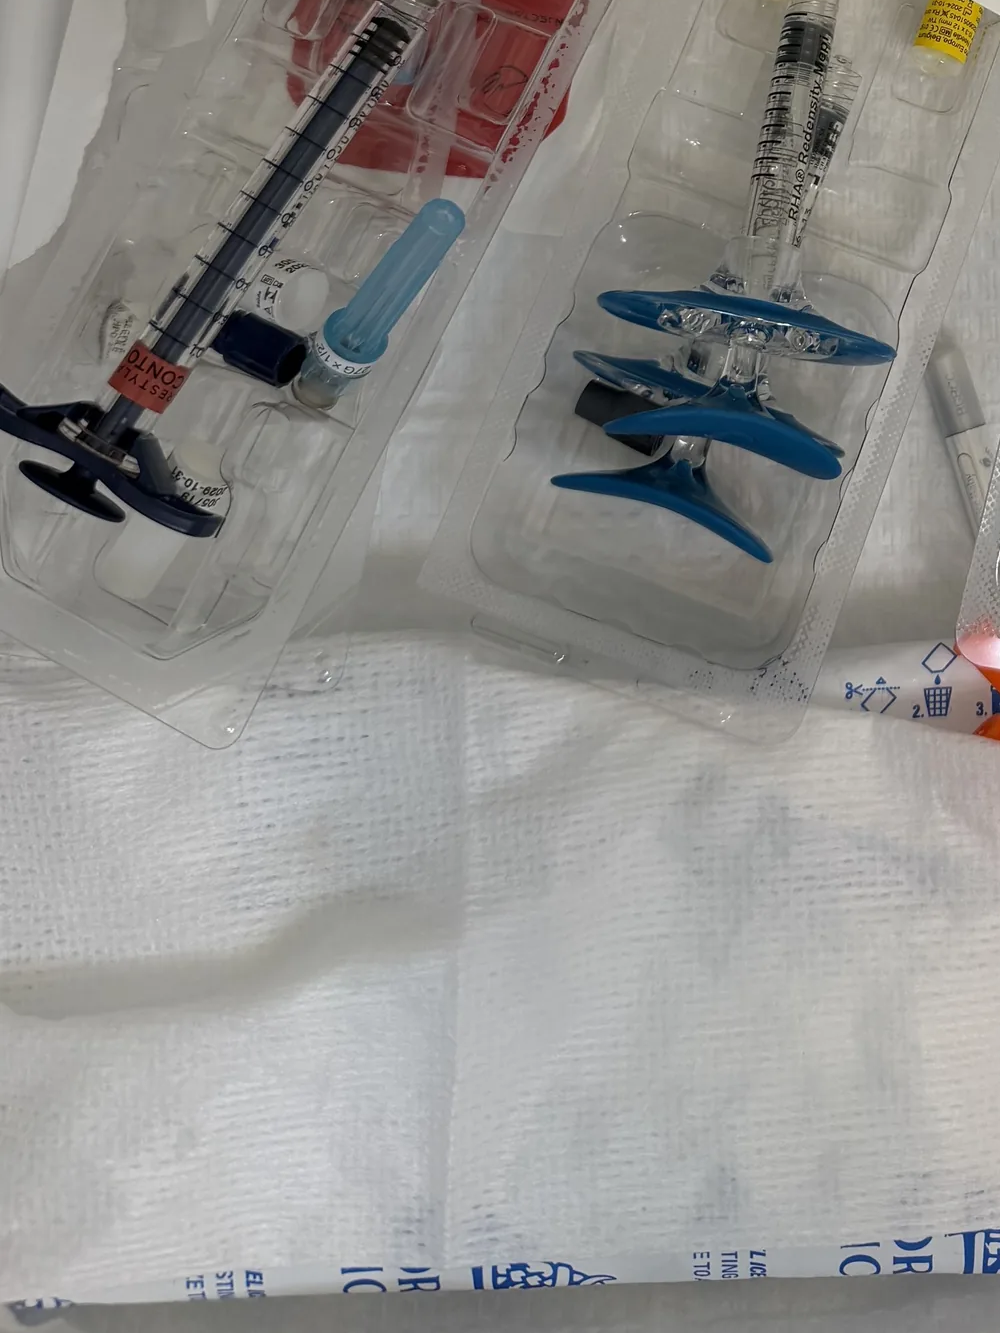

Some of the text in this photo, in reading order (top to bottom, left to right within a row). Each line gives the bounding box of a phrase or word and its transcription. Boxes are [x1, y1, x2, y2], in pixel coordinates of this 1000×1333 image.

[799, 79, 823, 166] Redensity
[113, 363, 175, 405] RESTYLA
[123, 347, 186, 392] CONTO
[912, 704, 925, 718] 2.
[976, 701, 988, 716] 3.
